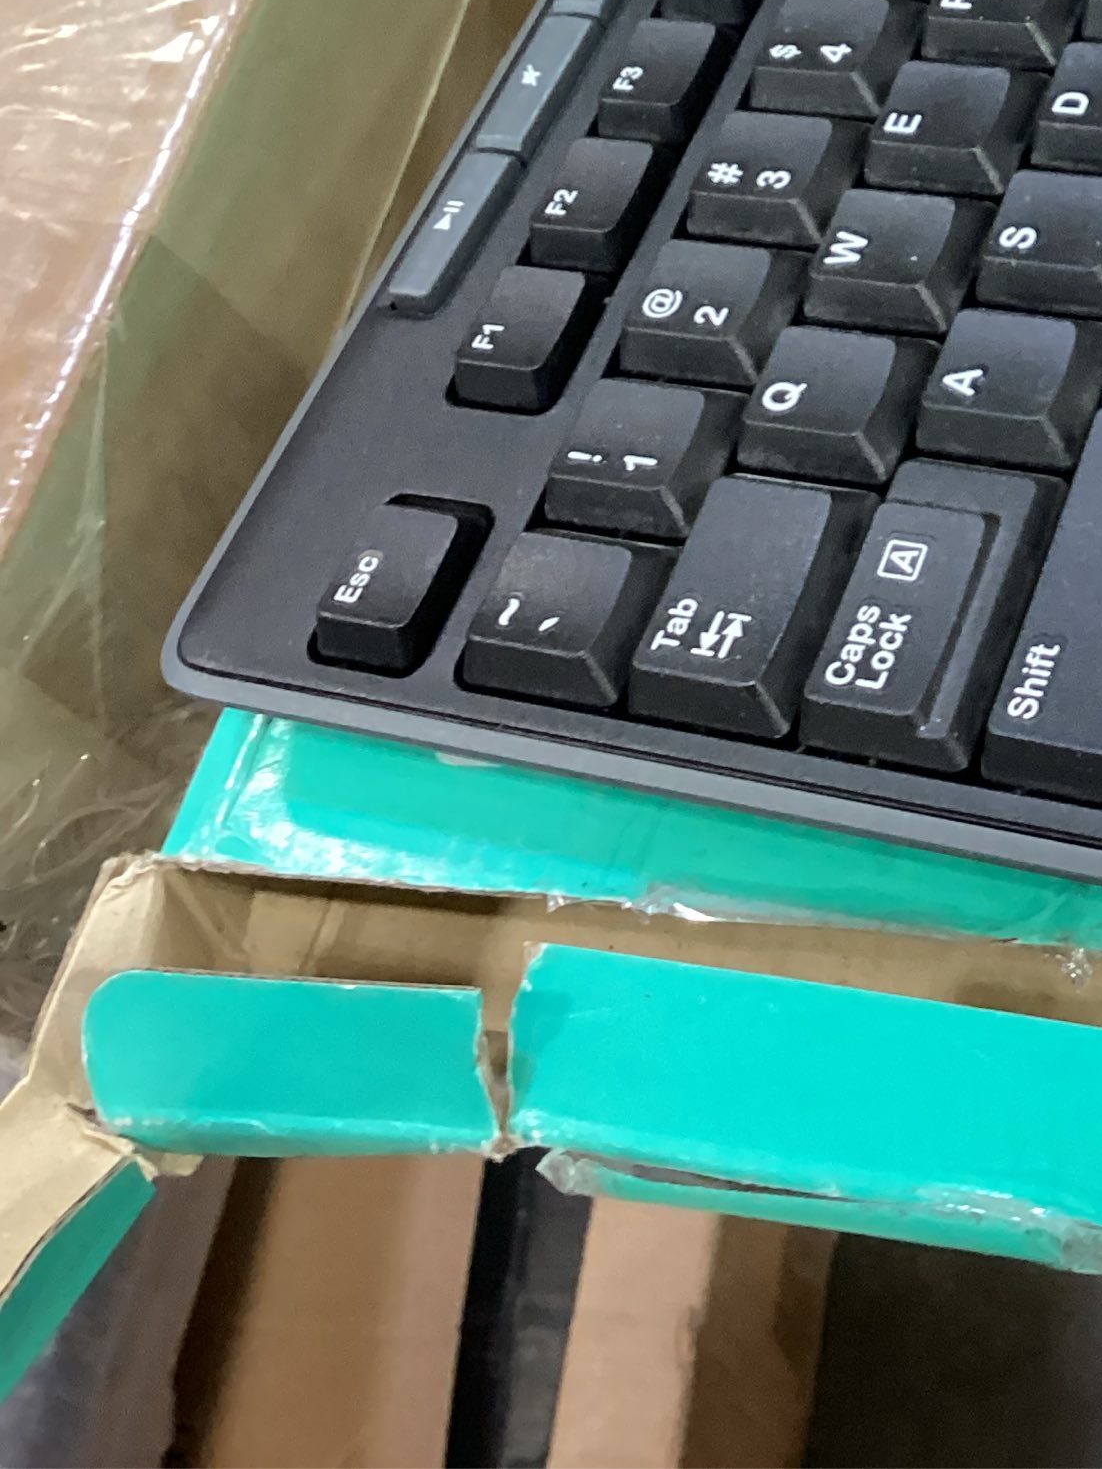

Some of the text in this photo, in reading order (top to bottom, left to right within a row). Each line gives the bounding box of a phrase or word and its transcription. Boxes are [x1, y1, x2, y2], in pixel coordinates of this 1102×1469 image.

[769, 45, 801, 59] $
[820, 44, 851, 63] 4
[613, 67, 643, 91] F3
[1052, 92, 1089, 115] D
[884, 113, 921, 134] E
[708, 163, 743, 184] #
[757, 171, 790, 189] 3
[545, 190, 578, 215] F2
[824, 231, 868, 264] W
[999, 227, 1036, 249] S
[642, 289, 682, 318] @
[694, 306, 728, 326] 2
[472, 324, 504, 349] F1
[943, 370, 983, 396] A
[762, 382, 807, 411] Q
[567, 451, 603, 463] !
[624, 455, 657, 471] 1
[334, 551, 382, 603] Esc
[499, 599, 520, 625] ~
[651, 599, 702, 655] Tab
[823, 601, 881, 688] Caps
[855, 611, 912, 691] Lock
[1007, 644, 1060, 719] Shift
